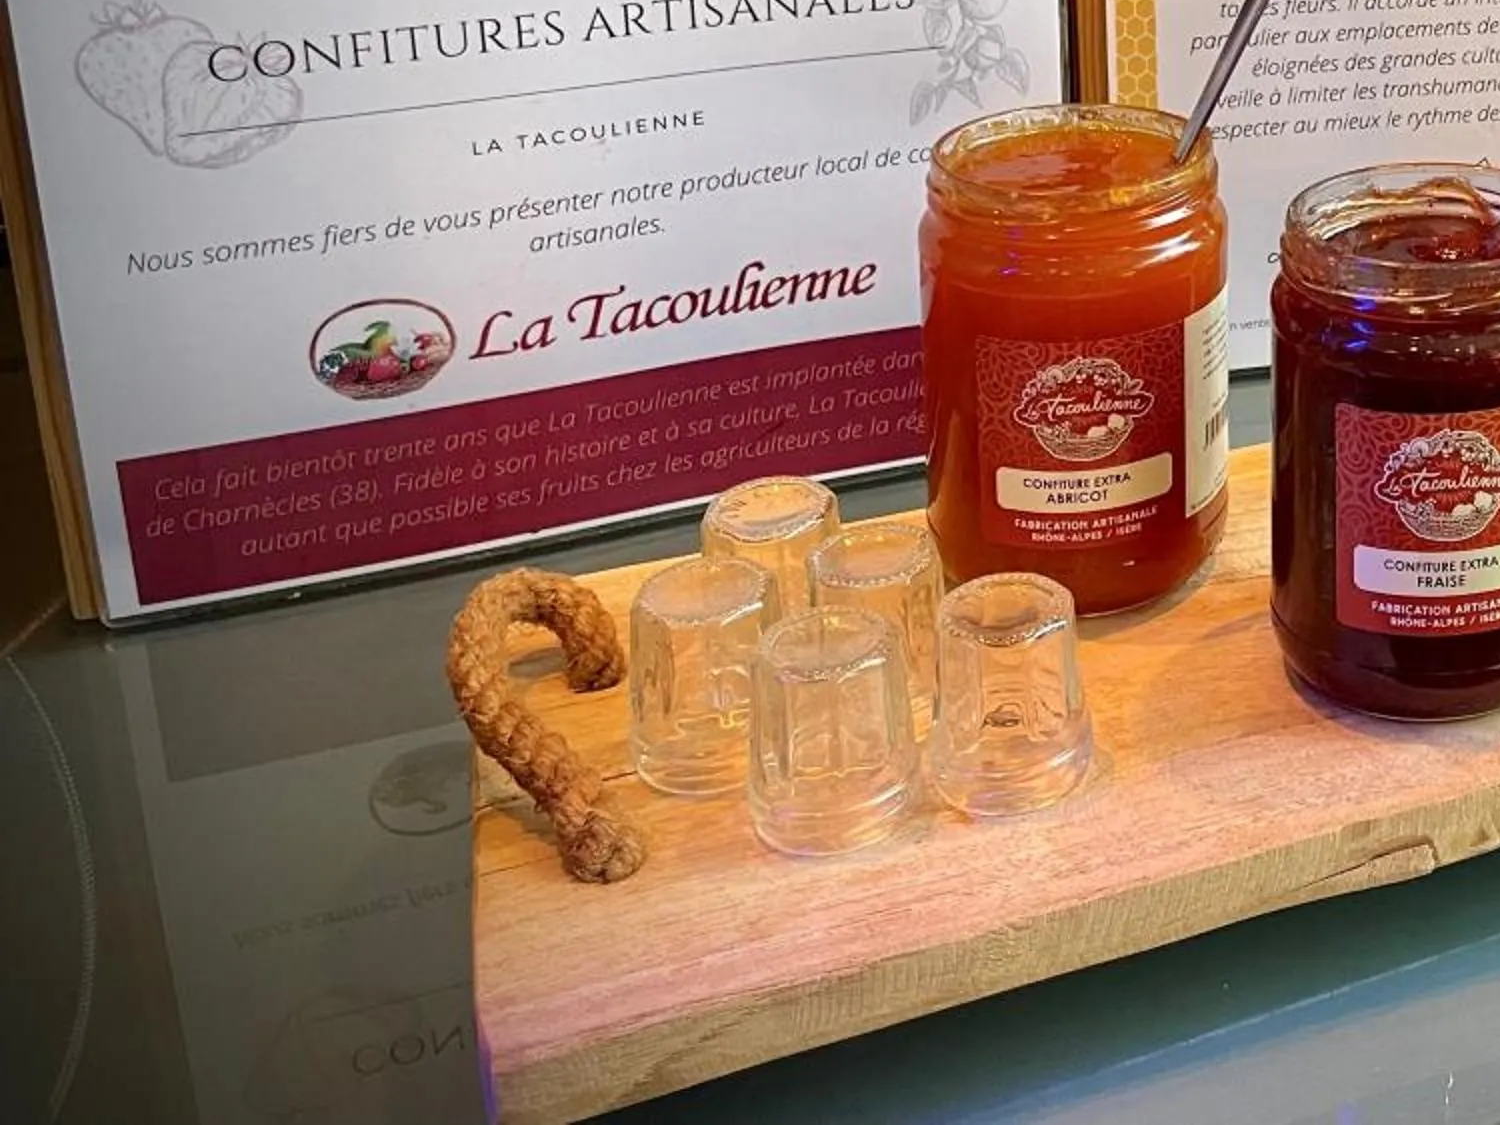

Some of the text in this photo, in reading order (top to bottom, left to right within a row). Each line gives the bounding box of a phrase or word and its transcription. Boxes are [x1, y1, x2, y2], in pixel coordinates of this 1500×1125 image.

[207, 10, 566, 82] CONFITURES
[1295, 28, 1330, 44] aux
[1336, 18, 1471, 45] emplacements
[1477, 15, 1499, 34] de
[1251, 54, 1339, 80] éloignées
[1345, 52, 1377, 72] des
[1379, 48, 1457, 74] grandes
[1269, 87, 1281, 106] à
[1287, 83, 1347, 105] limiter
[1353, 82, 1377, 100] les
[471, 110, 706, 157] LA TACOULIENNE
[1211, 119, 1288, 142] especter
[1294, 119, 1318, 134] au
[1324, 112, 1381, 131] mieux
[1387, 110, 1402, 129] le
[1407, 107, 1473, 132] rythme
[127, 249, 194, 275] Nous
[202, 234, 315, 265] sommes
[321, 222, 377, 254] fiers
[384, 215, 416, 238] de
[423, 208, 482, 234] vous
[488, 189, 604, 229] présenter
[610, 178, 674, 207] notre
[678, 159, 809, 200] producteur
[814, 150, 869, 177] local
[875, 146, 901, 168] de
[529, 215, 666, 253] artisanales.
[468, 261, 878, 360] La Tacoulienne
[1039, 391, 1145, 422] Tacoulienne
[155, 351, 925, 501] Cela fait bientôt trente ans que La Tacoulienne est implantée dan
[146, 515, 175, 539] de
[183, 491, 321, 531] Charnècles
[330, 482, 383, 510] (38).
[394, 463, 464, 493] Fidèle
[471, 458, 486, 481] à
[494, 450, 537, 476] son
[545, 433, 631, 464] histoire
[637, 426, 659, 447] et
[664, 417, 681, 442] à
[686, 416, 712, 438] sa
[808, 393, 835, 415] La
[1023, 472, 1131, 490] CONFITURE EXTRA
[241, 526, 327, 557] autant
[335, 516, 382, 543] que
[389, 496, 488, 535] possible
[496, 490, 531, 509] ses
[536, 476, 600, 507] fruits
[606, 459, 657, 486] chez
[664, 451, 693, 472] les
[700, 428, 831, 468] agriculteurs
[837, 420, 864, 442] de
[870, 415, 889, 436] la
[1046, 489, 1108, 504] ABRICOT
[1014, 505, 1158, 531] FABRICATION ARTISANALE
[1383, 556, 1499, 572] CONFITURE EXTRA
[1417, 575, 1467, 588] FRAISE
[1371, 600, 1450, 616] FABRICATION
